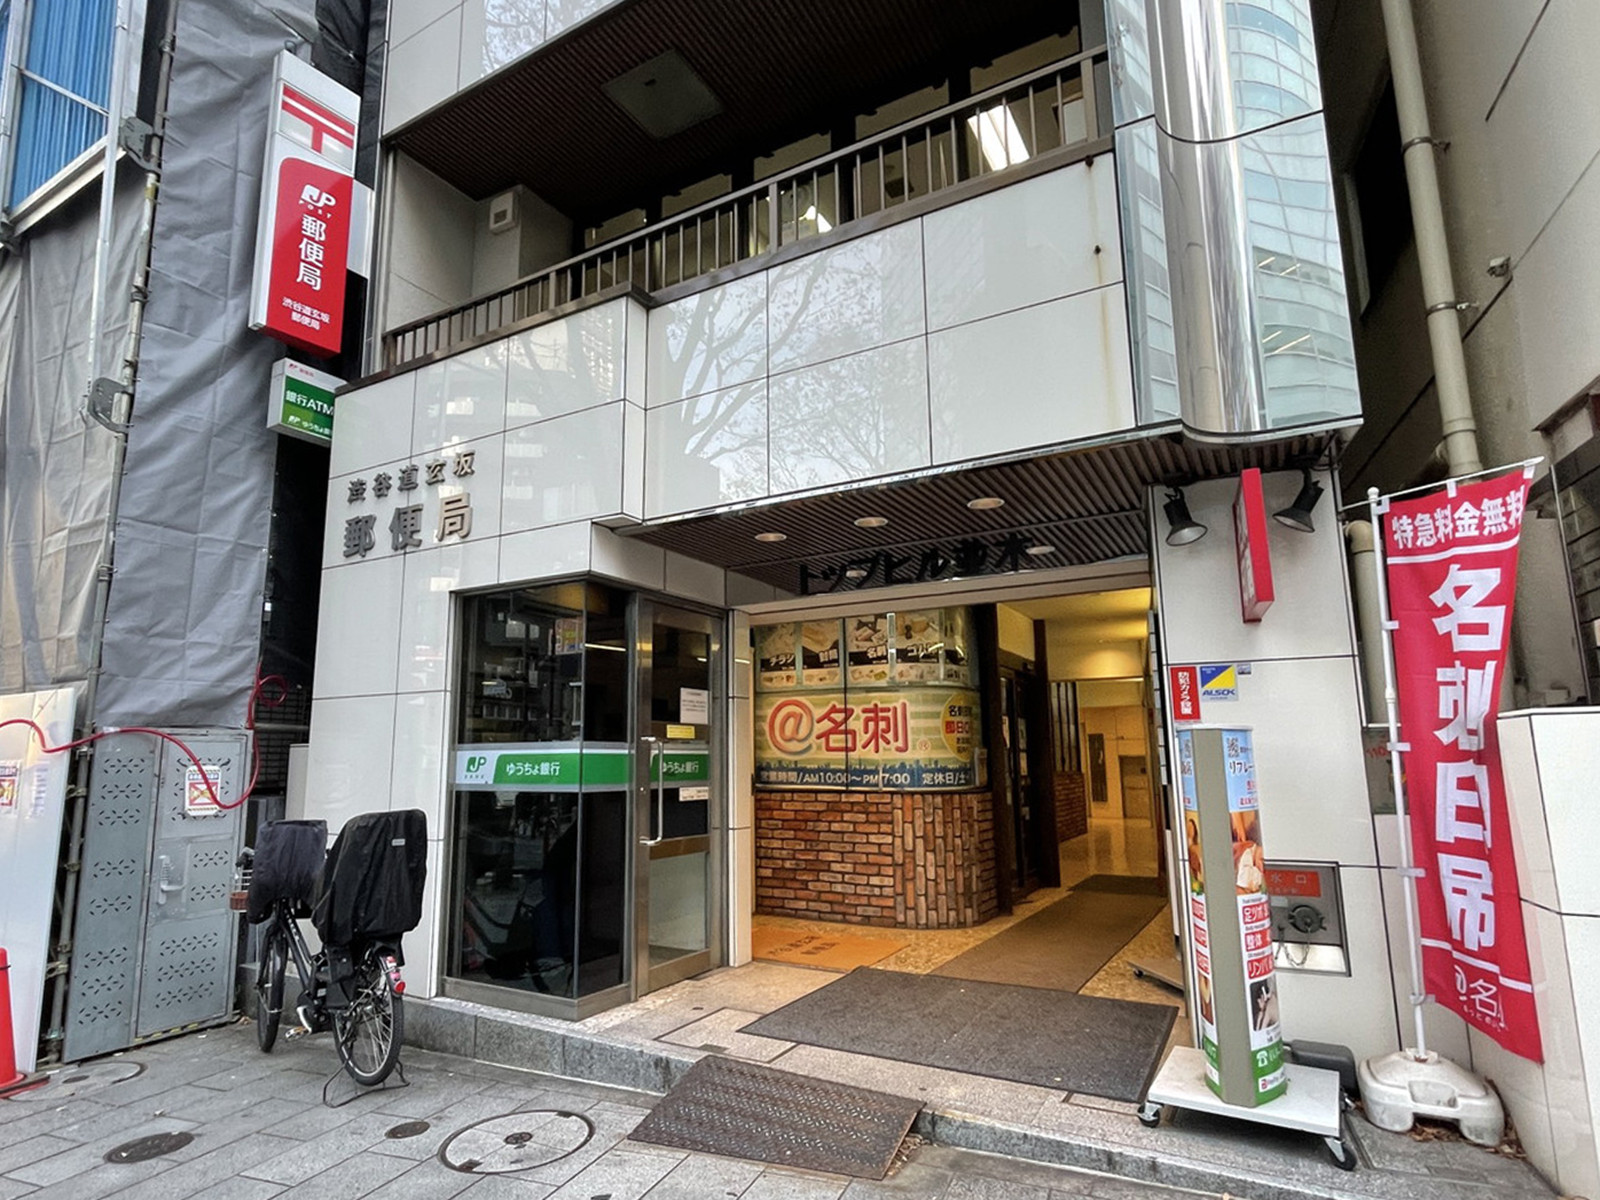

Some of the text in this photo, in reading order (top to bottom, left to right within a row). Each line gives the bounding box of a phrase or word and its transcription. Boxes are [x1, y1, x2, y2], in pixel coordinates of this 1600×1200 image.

[297, 214, 327, 291] 郵便局
[291, 310, 320, 330] 郵便局
[343, 492, 474, 559] 郵便局
[1392, 484, 1525, 550] 特急料金無料
[1202, 688, 1236, 697] ALSOK
[768, 699, 910, 757] @名刺
[506, 762, 560, 776] ゆうちょ銀行
